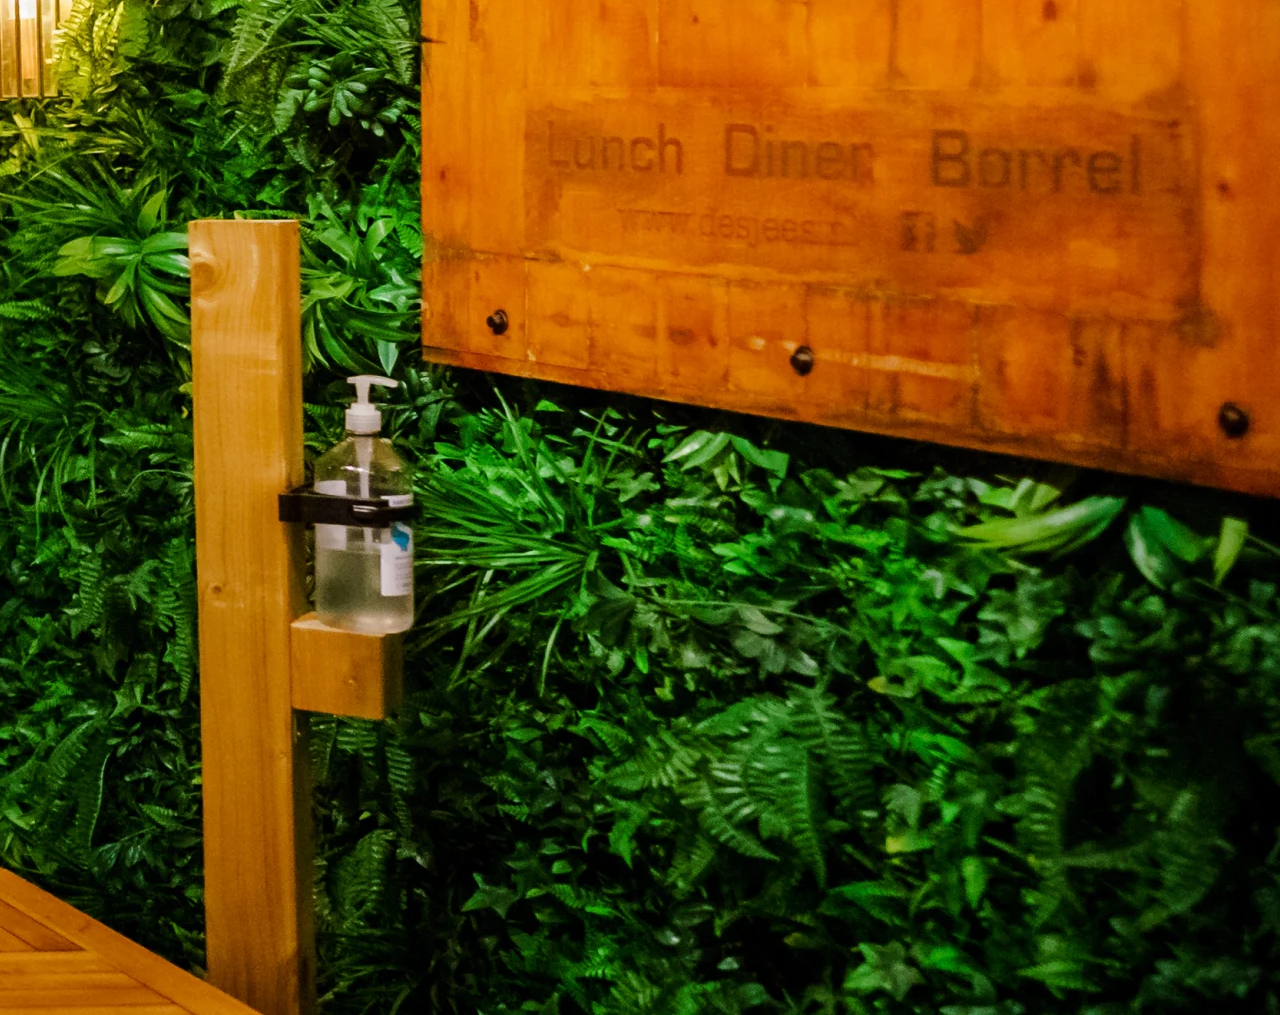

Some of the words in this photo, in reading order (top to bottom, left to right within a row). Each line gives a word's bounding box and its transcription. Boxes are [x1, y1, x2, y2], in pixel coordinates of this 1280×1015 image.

[547, 121, 684, 175] Lunch
[724, 123, 873, 181] Diner
[930, 128, 1141, 195] Borrel
